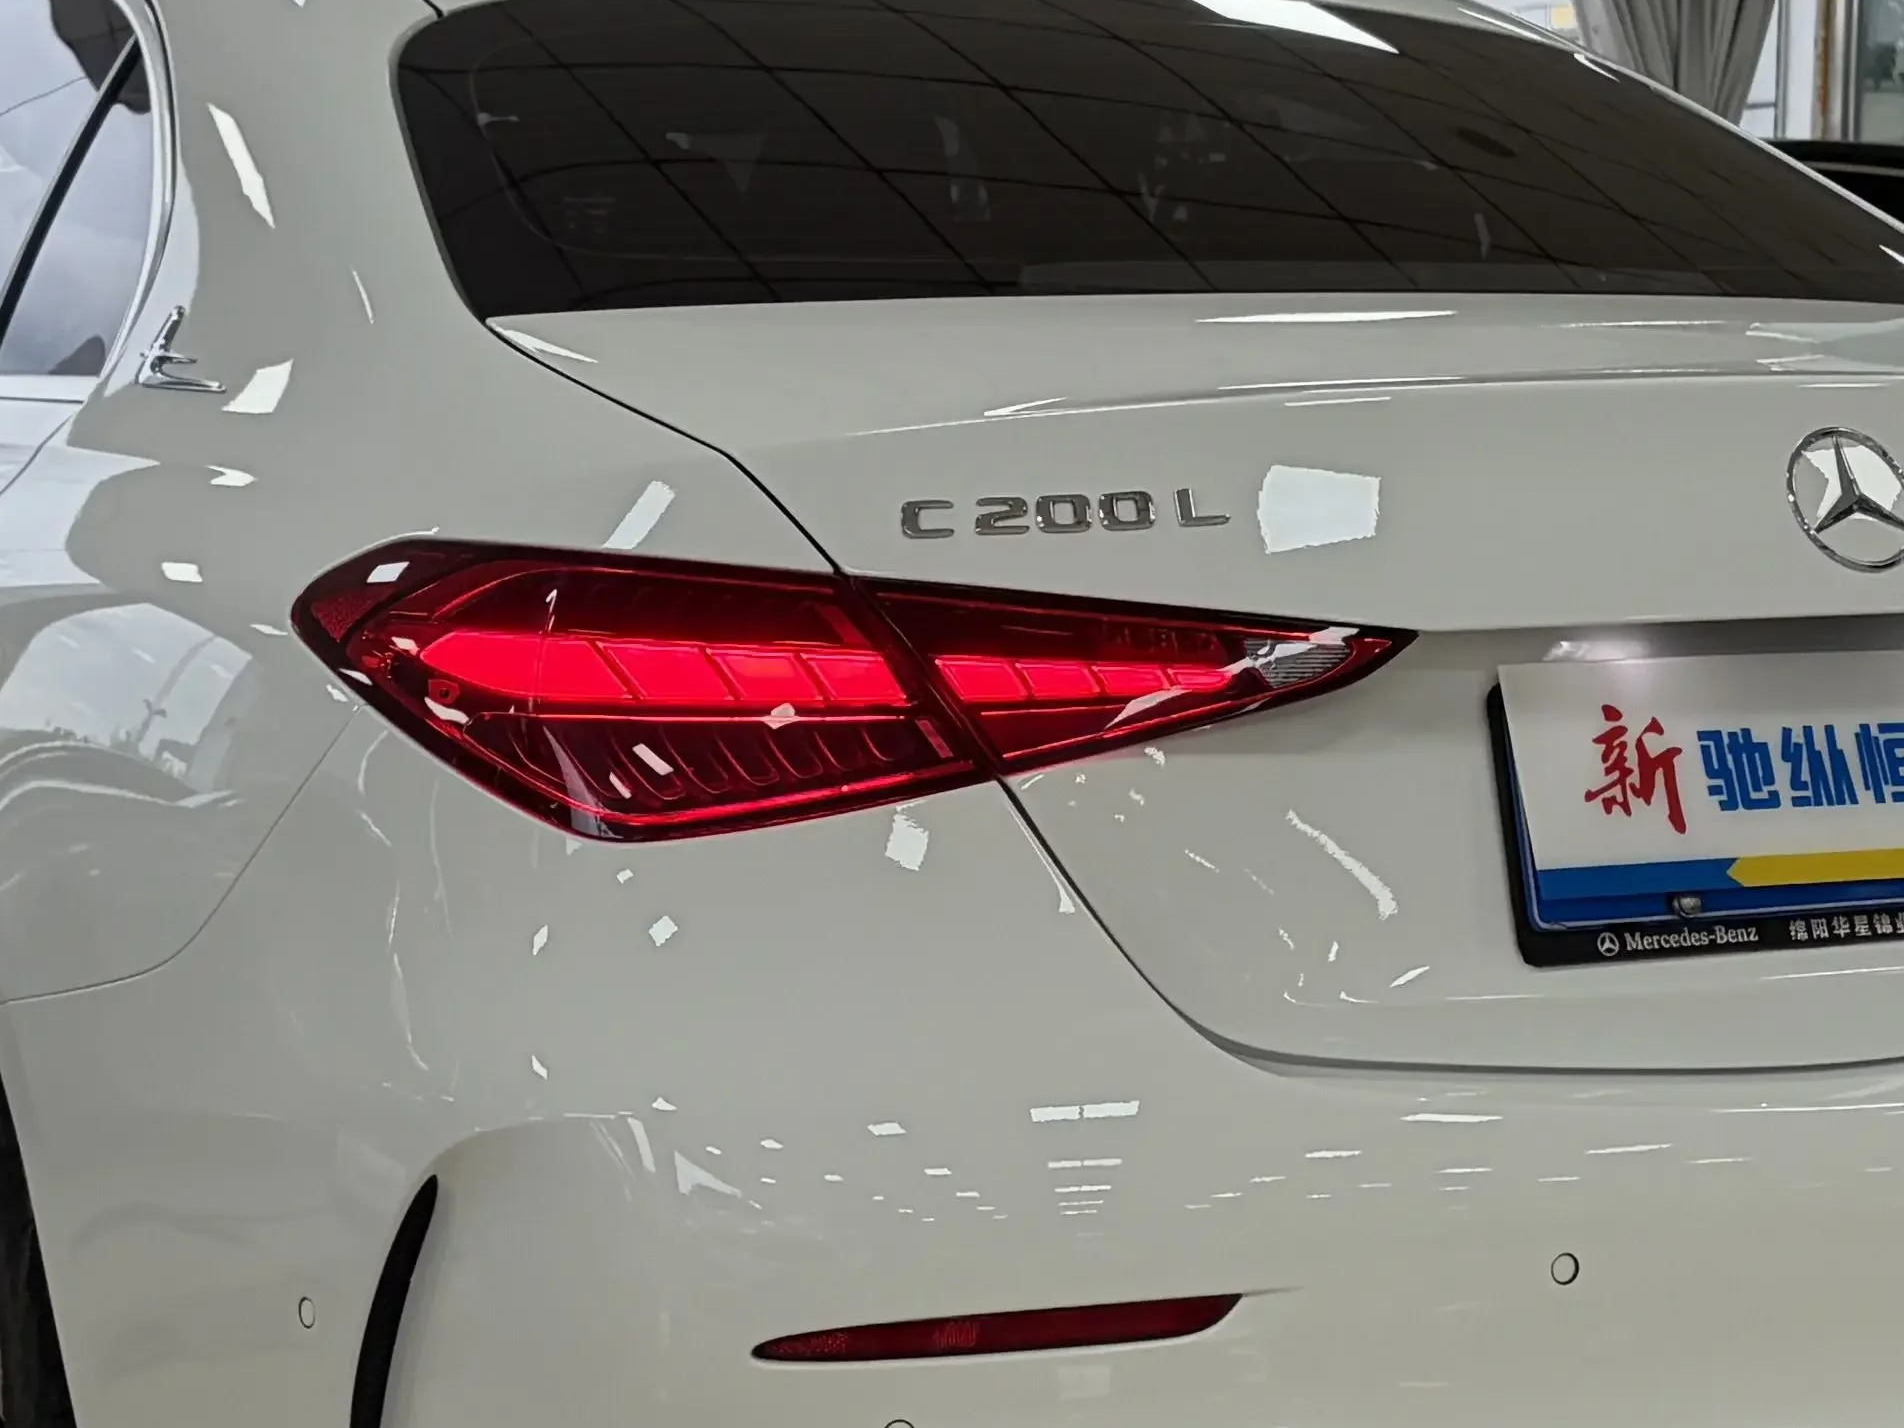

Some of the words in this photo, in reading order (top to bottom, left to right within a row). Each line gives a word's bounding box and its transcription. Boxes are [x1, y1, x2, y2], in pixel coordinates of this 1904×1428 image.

[901, 499, 955, 539] C
[975, 489, 1157, 535] 200
[1173, 487, 1232, 527] L
[1624, 925, 1759, 951] Mercedes-Benz
